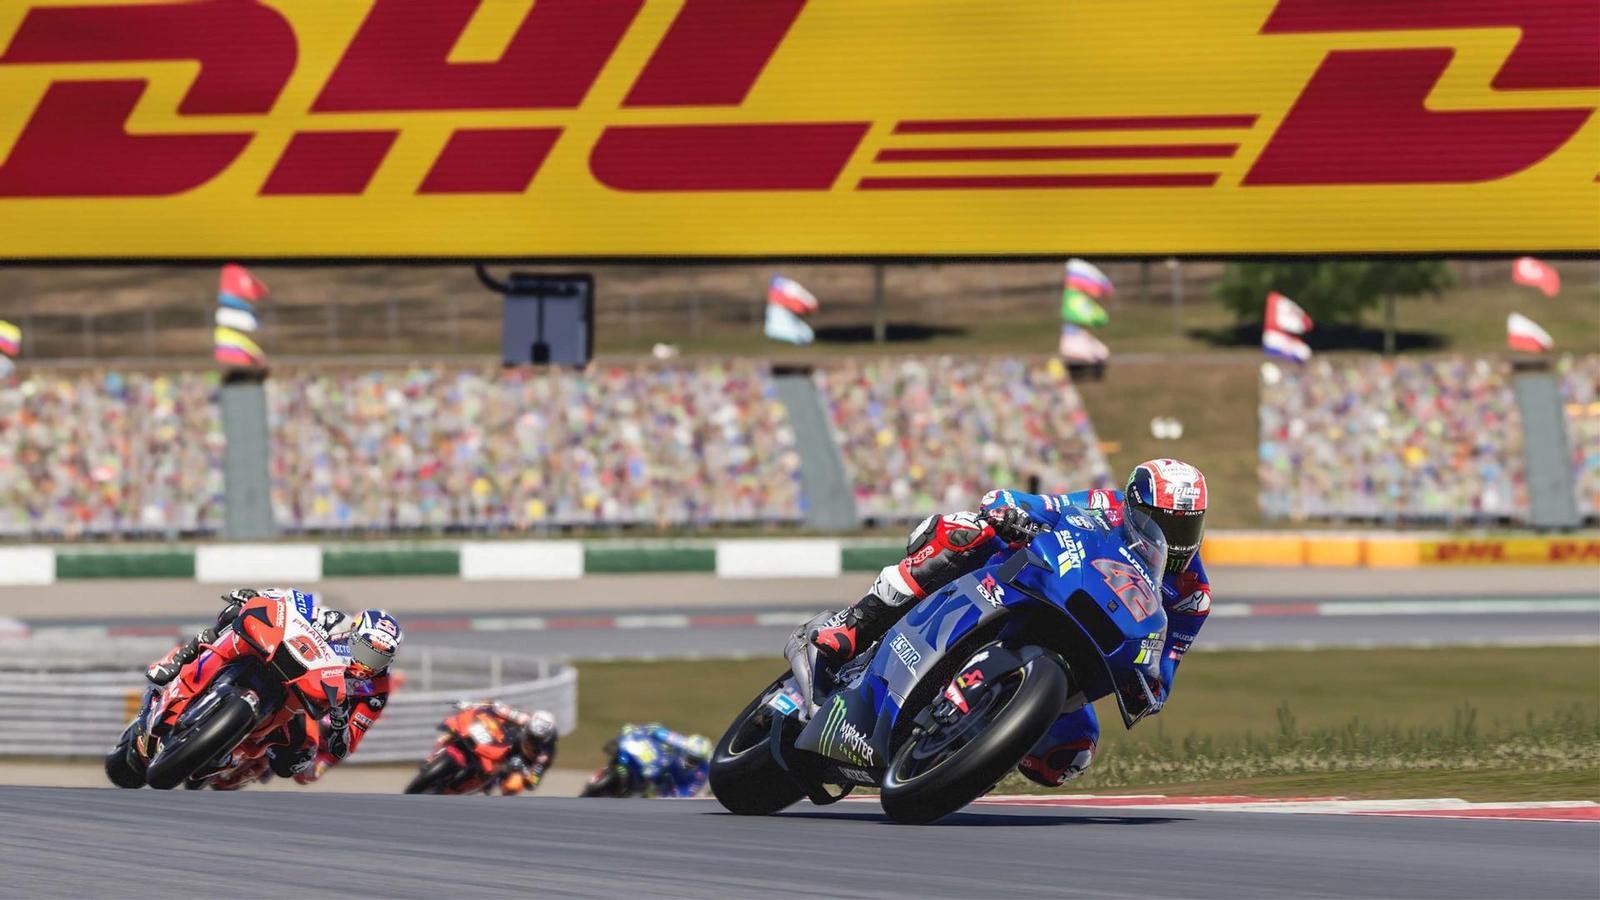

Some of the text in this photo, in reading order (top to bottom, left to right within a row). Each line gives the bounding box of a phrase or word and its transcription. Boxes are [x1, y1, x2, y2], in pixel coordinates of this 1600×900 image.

[0, 0, 872, 199] DHL
[1059, 530, 1082, 569] SUZUKI
[1118, 546, 1156, 592] SUZUKI
[1091, 558, 1158, 622] 42
[293, 618, 331, 662] PRAMAC
[889, 632, 922, 676] ECSTAR
[840, 719, 874, 767] MONSTER
